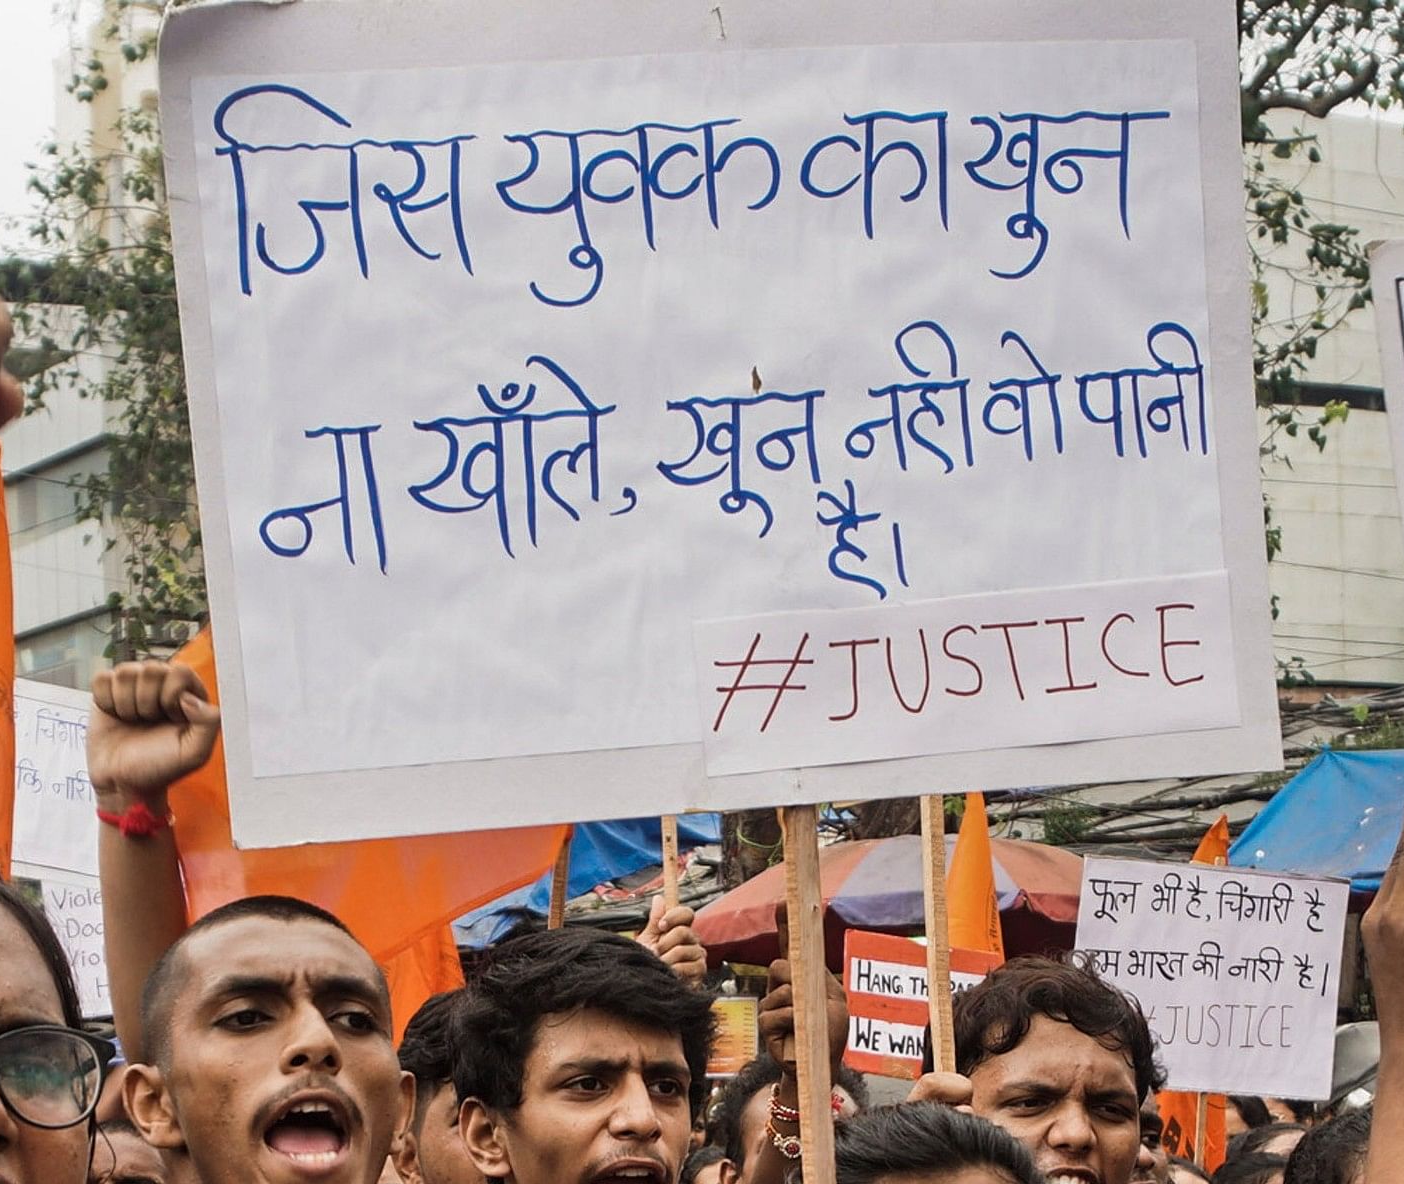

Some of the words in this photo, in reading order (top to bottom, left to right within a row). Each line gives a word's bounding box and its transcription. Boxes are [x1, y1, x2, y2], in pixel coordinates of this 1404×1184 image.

[214, 83, 477, 296] जिस
[496, 118, 783, 308] युवक
[799, 110, 948, 240] का
[259, 424, 388, 576] ना
[657, 389, 825, 539] खून
[983, 329, 1064, 462] वो
[1075, 321, 1209, 459] पानी
[712, 603, 1205, 733] #JUSTICE
[1088, 878, 1144, 924] फूल
[1150, 872, 1184, 915] भी
[1216, 879, 1296, 925] चिंगारी
[1303, 886, 1327, 933] है
[857, 959, 905, 995] HANG
[1127, 948, 1190, 982] भारत
[1192, 940, 1225, 982] की
[1228, 946, 1285, 985] नारी
[854, 1015, 882, 1052] WE
